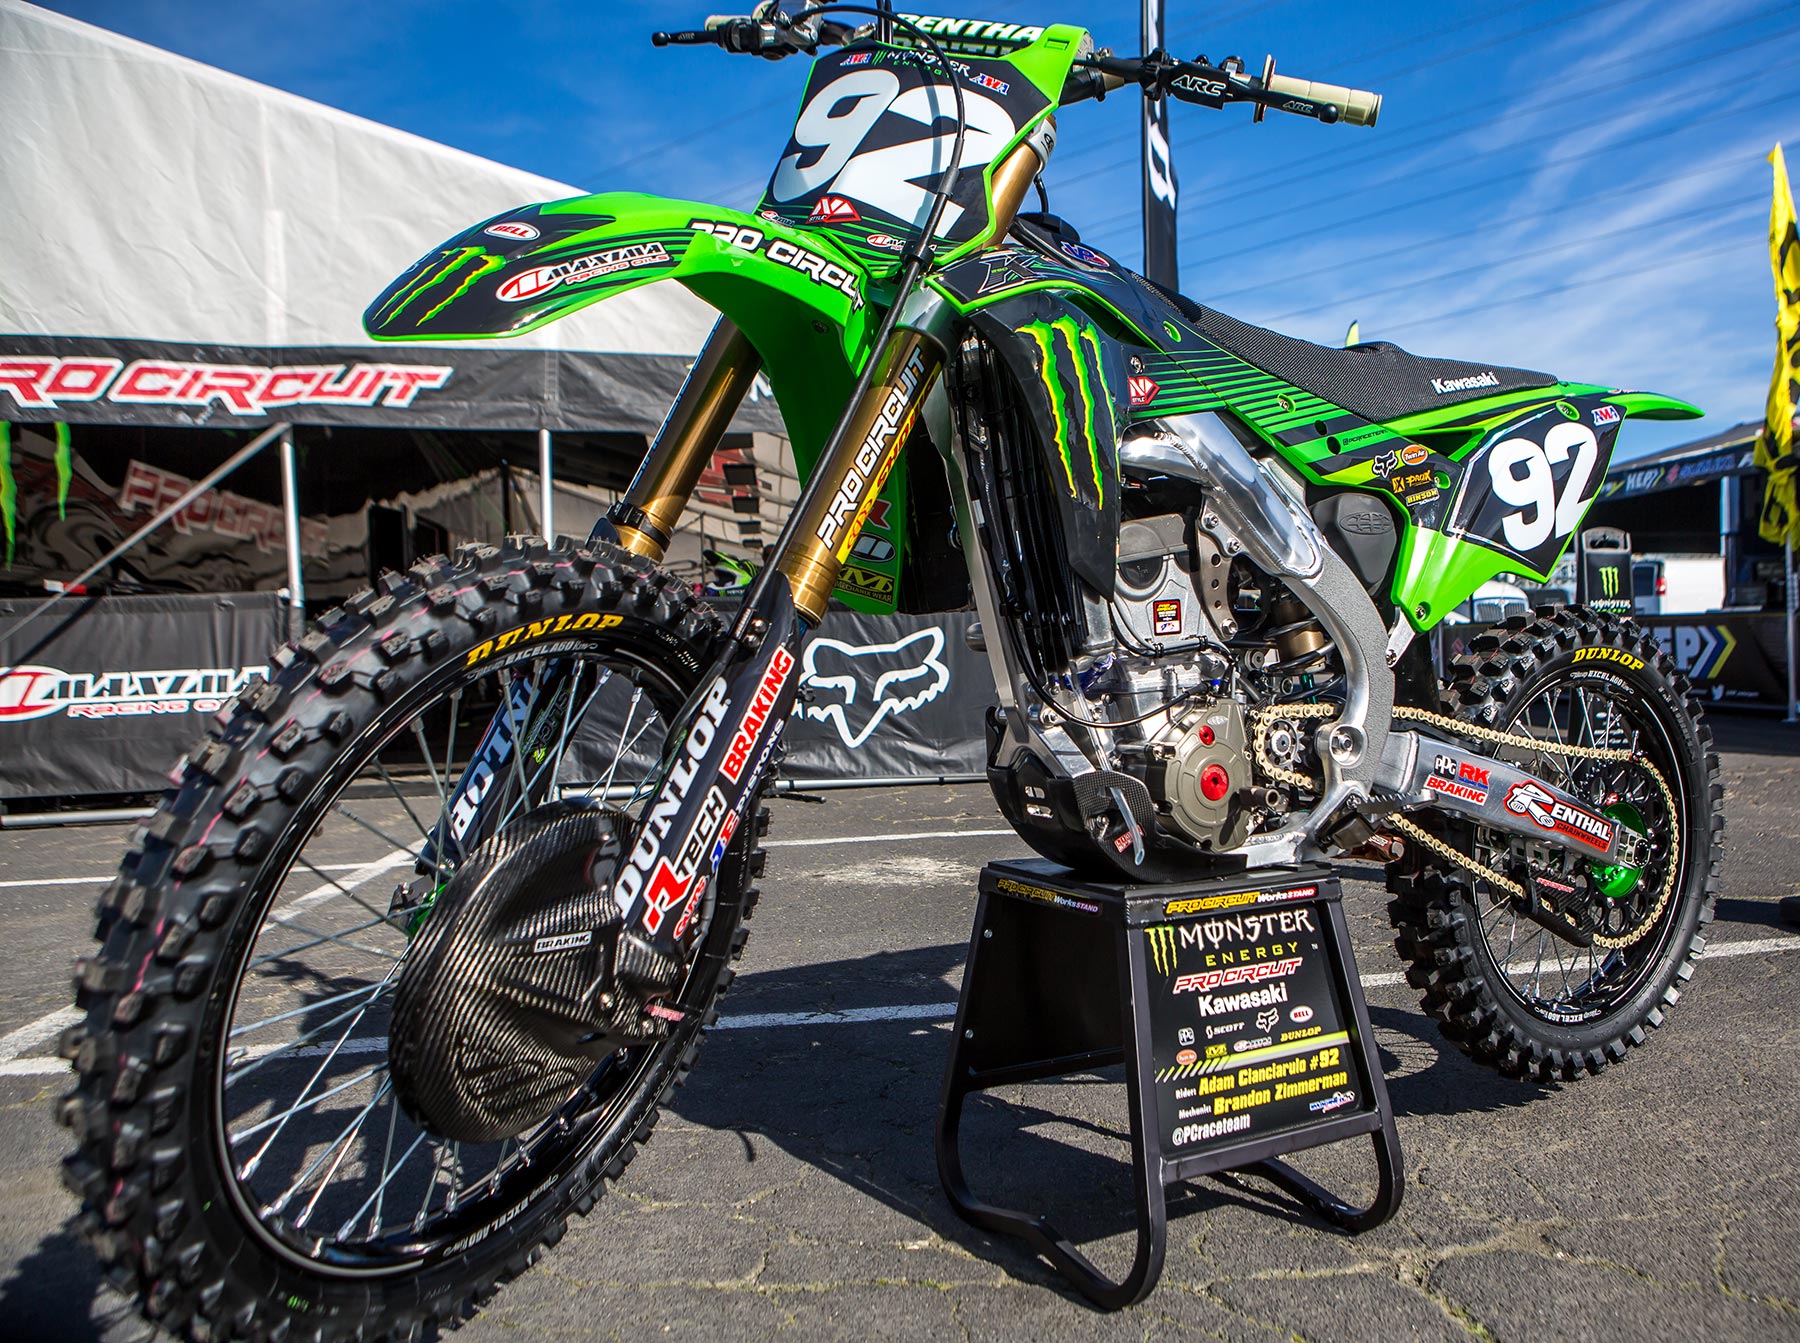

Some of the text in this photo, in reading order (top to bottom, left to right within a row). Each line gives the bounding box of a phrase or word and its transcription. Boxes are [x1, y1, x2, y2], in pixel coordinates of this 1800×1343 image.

[891, 13, 1045, 42] RENTHA
[969, 72, 1010, 96] AMA
[1171, 74, 1226, 97] ARC
[1283, 100, 1313, 113] ARC
[772, 69, 1017, 239] 92
[493, 224, 530, 238] BELL
[565, 254, 669, 285] RACING OILS
[0, 355, 454, 415] RO CIRCUIT
[1431, 371, 1500, 395] Kawasaki
[1593, 406, 1619, 424] AMA
[816, 347, 925, 551] PRO CIRCUIT
[1488, 422, 1598, 552] 92
[1572, 647, 1645, 671] DUNLOP
[1640, 625, 1701, 671] EP
[67, 700, 189, 719] RACING
[720, 645, 794, 781] BRAKING
[1434, 755, 1457, 775] PPG
[1459, 762, 1490, 786] RK
[614, 675, 730, 920] DUNLOP
[1426, 776, 1486, 804] BRAKING
[1556, 822, 1607, 849] CHAINWHEELS
[1166, 899, 1201, 914] PRO
[1201, 892, 1260, 910] CIRCUIT
[536, 934, 590, 950] BRAKING
[1178, 909, 1316, 951] MONSTER
[1205, 941, 1298, 967] ENERGY
[1173, 957, 1303, 995] PRO CIRCUIT
[1198, 982, 1289, 1017] Kawasaki
[1213, 1021, 1245, 1035] SCOTT
[1293, 1010, 1309, 1019] BELL
[1280, 1026, 1322, 1042] DUNLOP
[1198, 1075, 1235, 1097] Adam
[1238, 1057, 1307, 1087] Cianciarulo
[1309, 1047, 1340, 1071] #92
[1213, 1089, 1271, 1115] Brandon
[1274, 1071, 1348, 1101] Zimmerman
[1172, 1113, 1251, 1146] @PCraceteam
